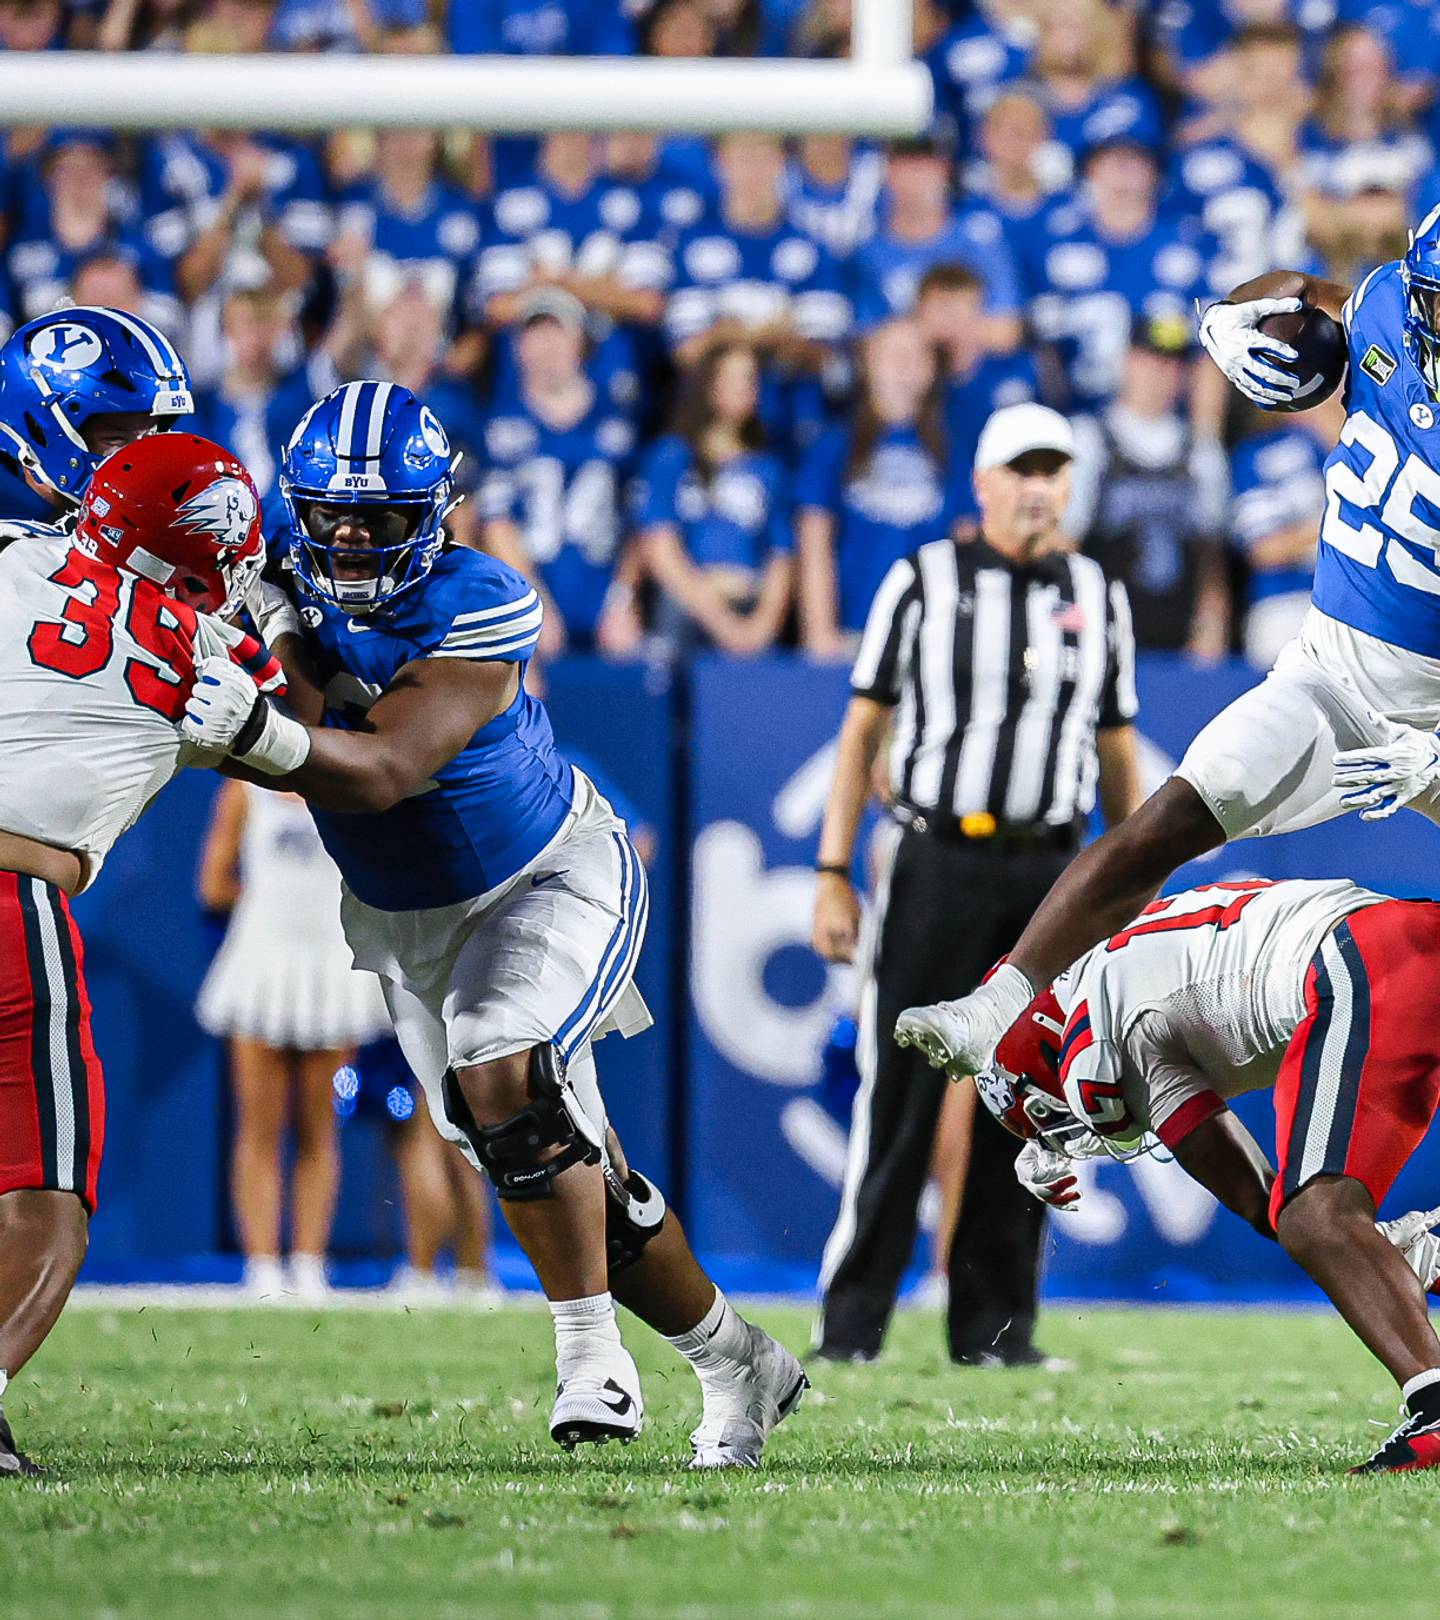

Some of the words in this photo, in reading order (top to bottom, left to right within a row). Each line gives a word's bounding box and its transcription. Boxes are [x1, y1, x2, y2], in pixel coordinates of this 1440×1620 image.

[45, 326, 94, 364] Y
[171, 395, 187, 409] BYU
[344, 475, 369, 488] BYU
[26, 547, 199, 725] 39
